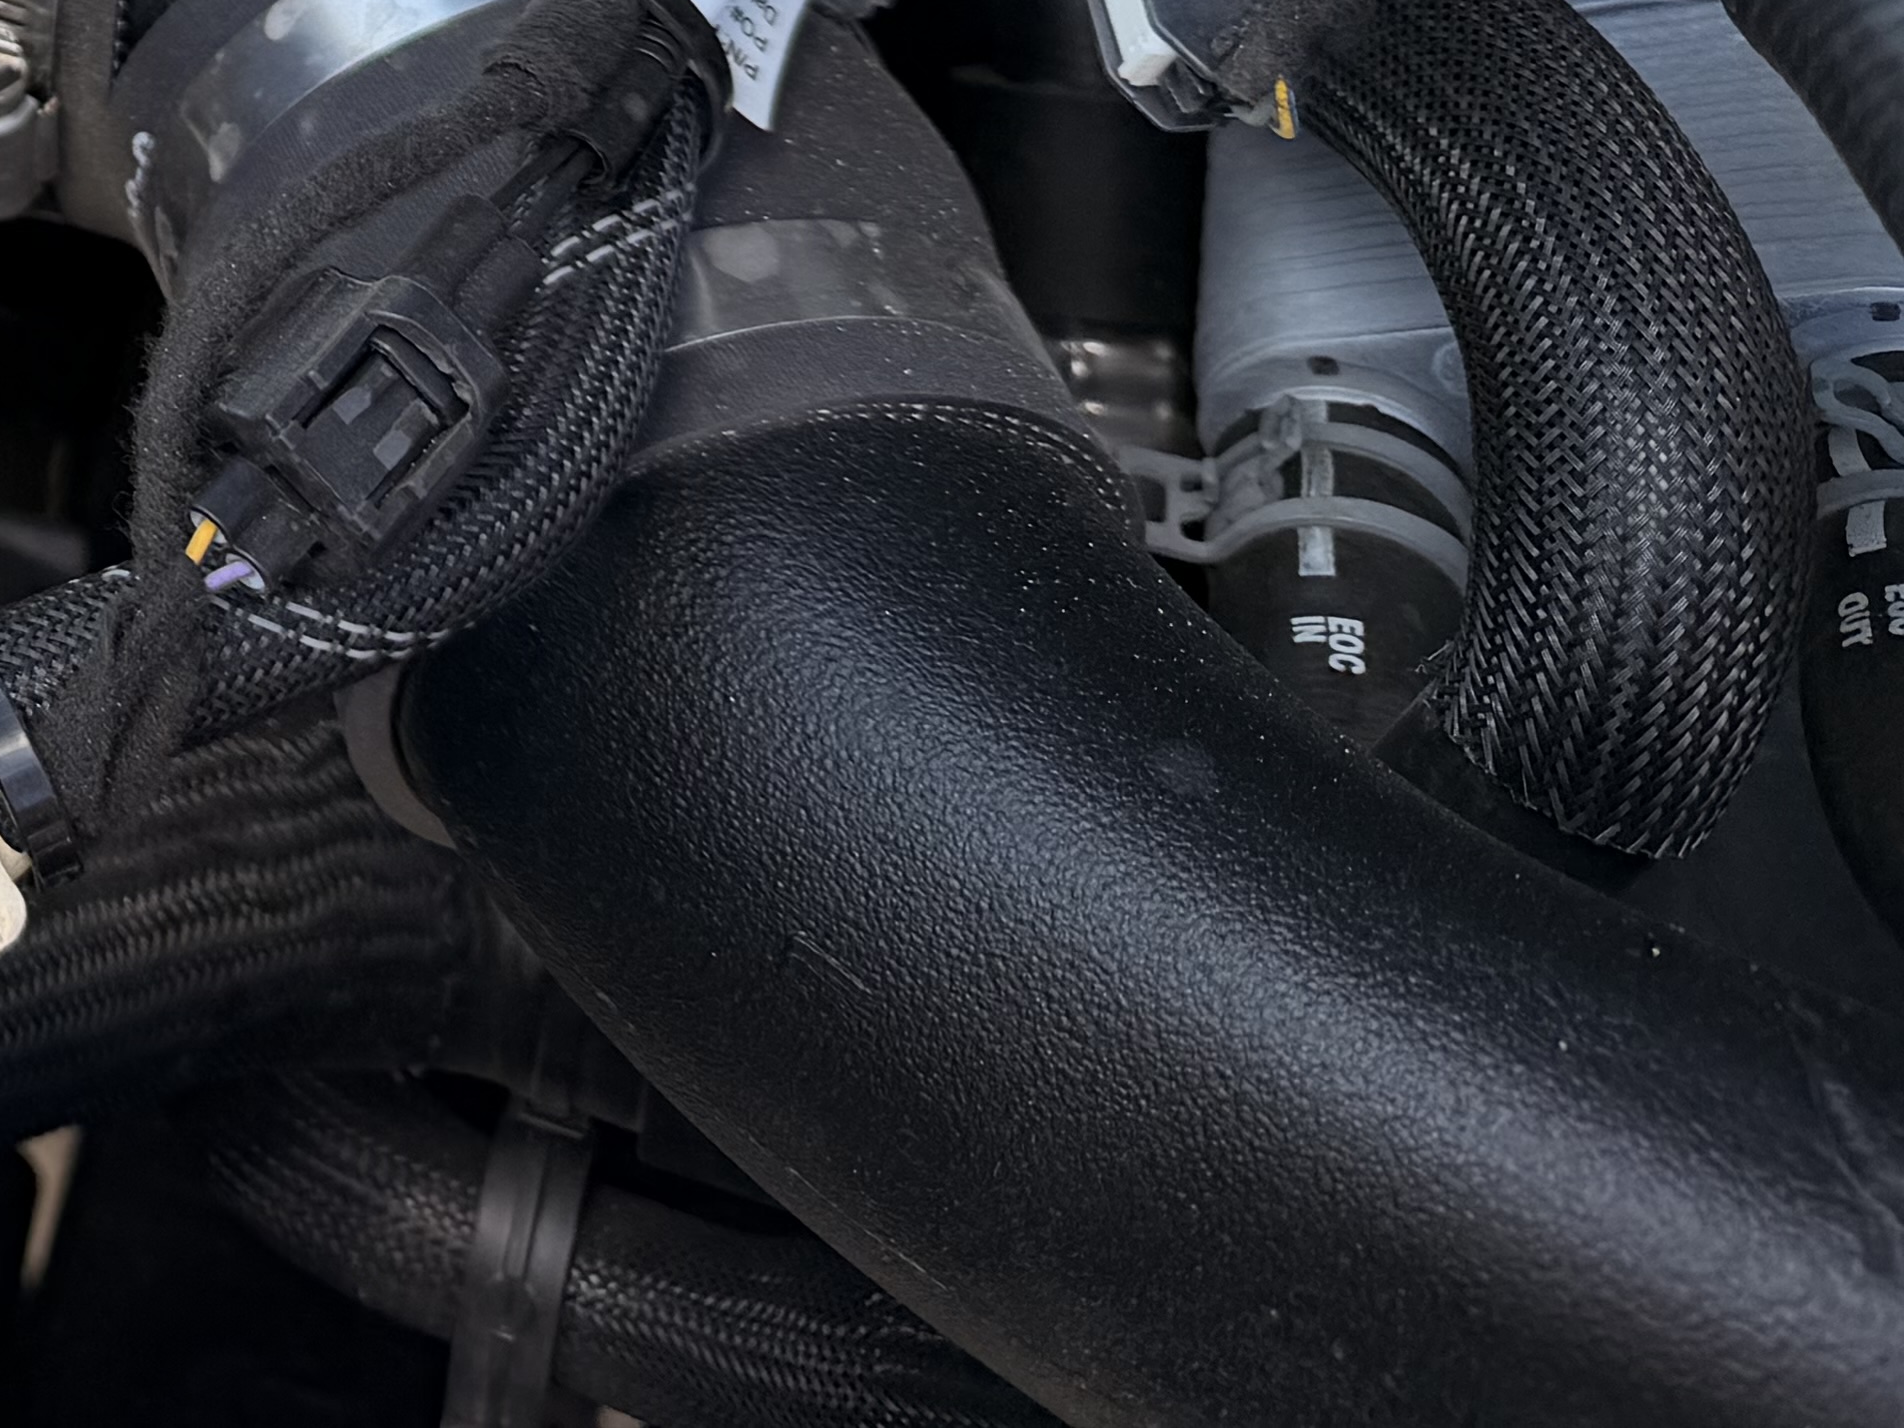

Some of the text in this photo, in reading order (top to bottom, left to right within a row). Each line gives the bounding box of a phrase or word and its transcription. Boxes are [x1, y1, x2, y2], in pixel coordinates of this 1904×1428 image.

[1289, 614, 1327, 644] IN
[1327, 615, 1366, 675] EOC
[1837, 591, 1873, 648] OUT
